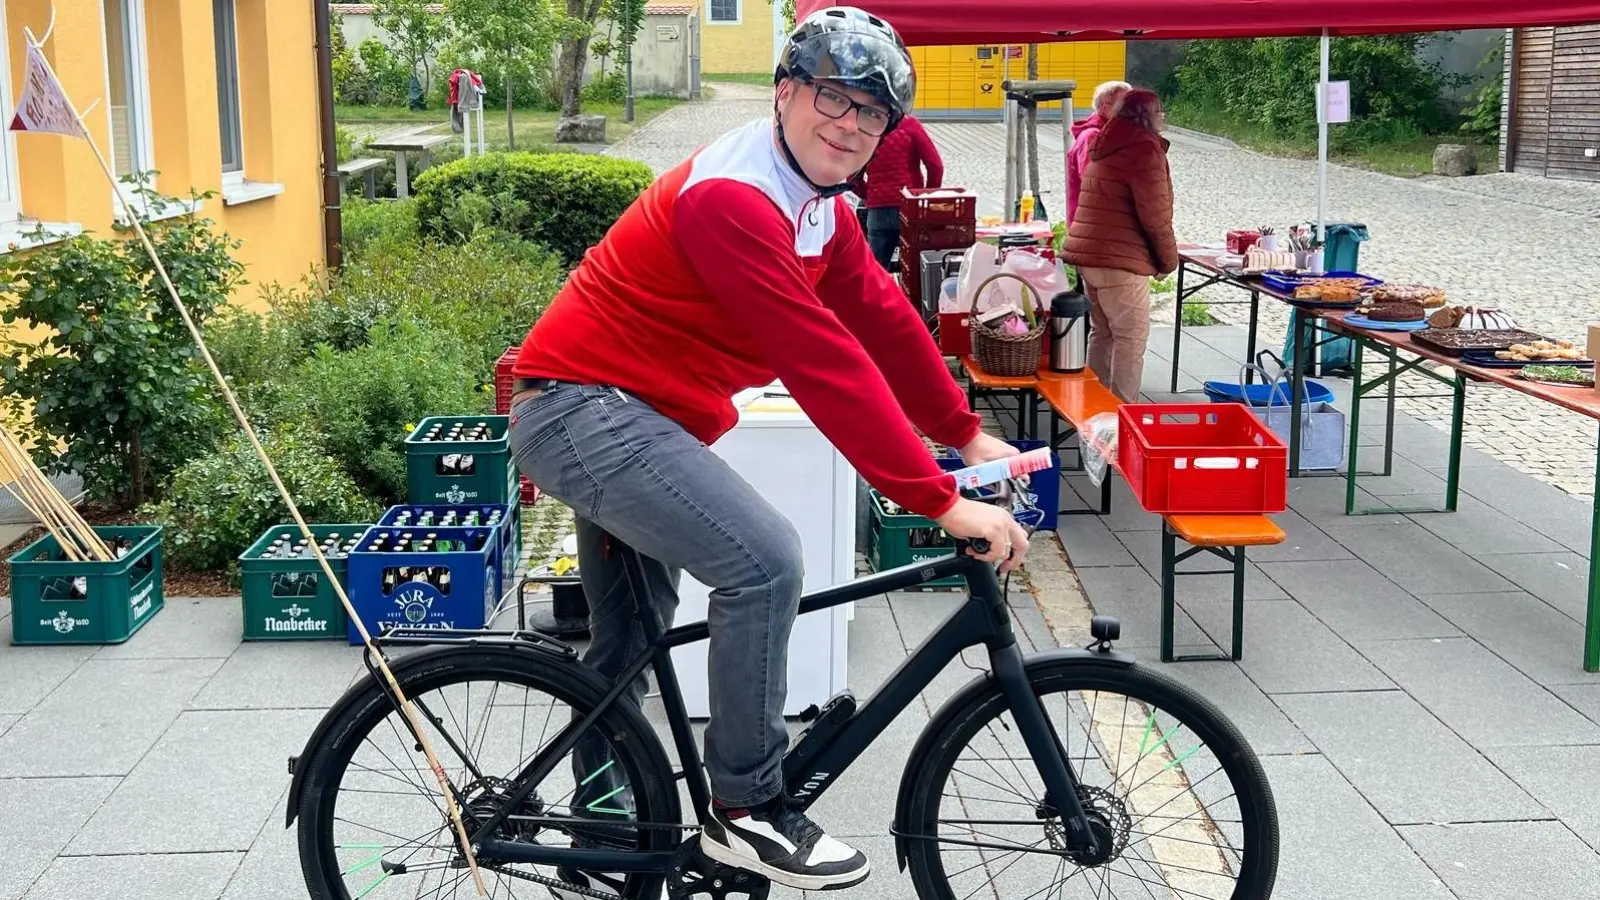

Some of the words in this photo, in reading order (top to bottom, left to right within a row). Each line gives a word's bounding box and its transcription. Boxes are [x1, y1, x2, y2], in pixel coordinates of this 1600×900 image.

[394, 589, 434, 609] JURA
[264, 616, 328, 632] Naabecker
[377, 620, 455, 631] WEIZEN
